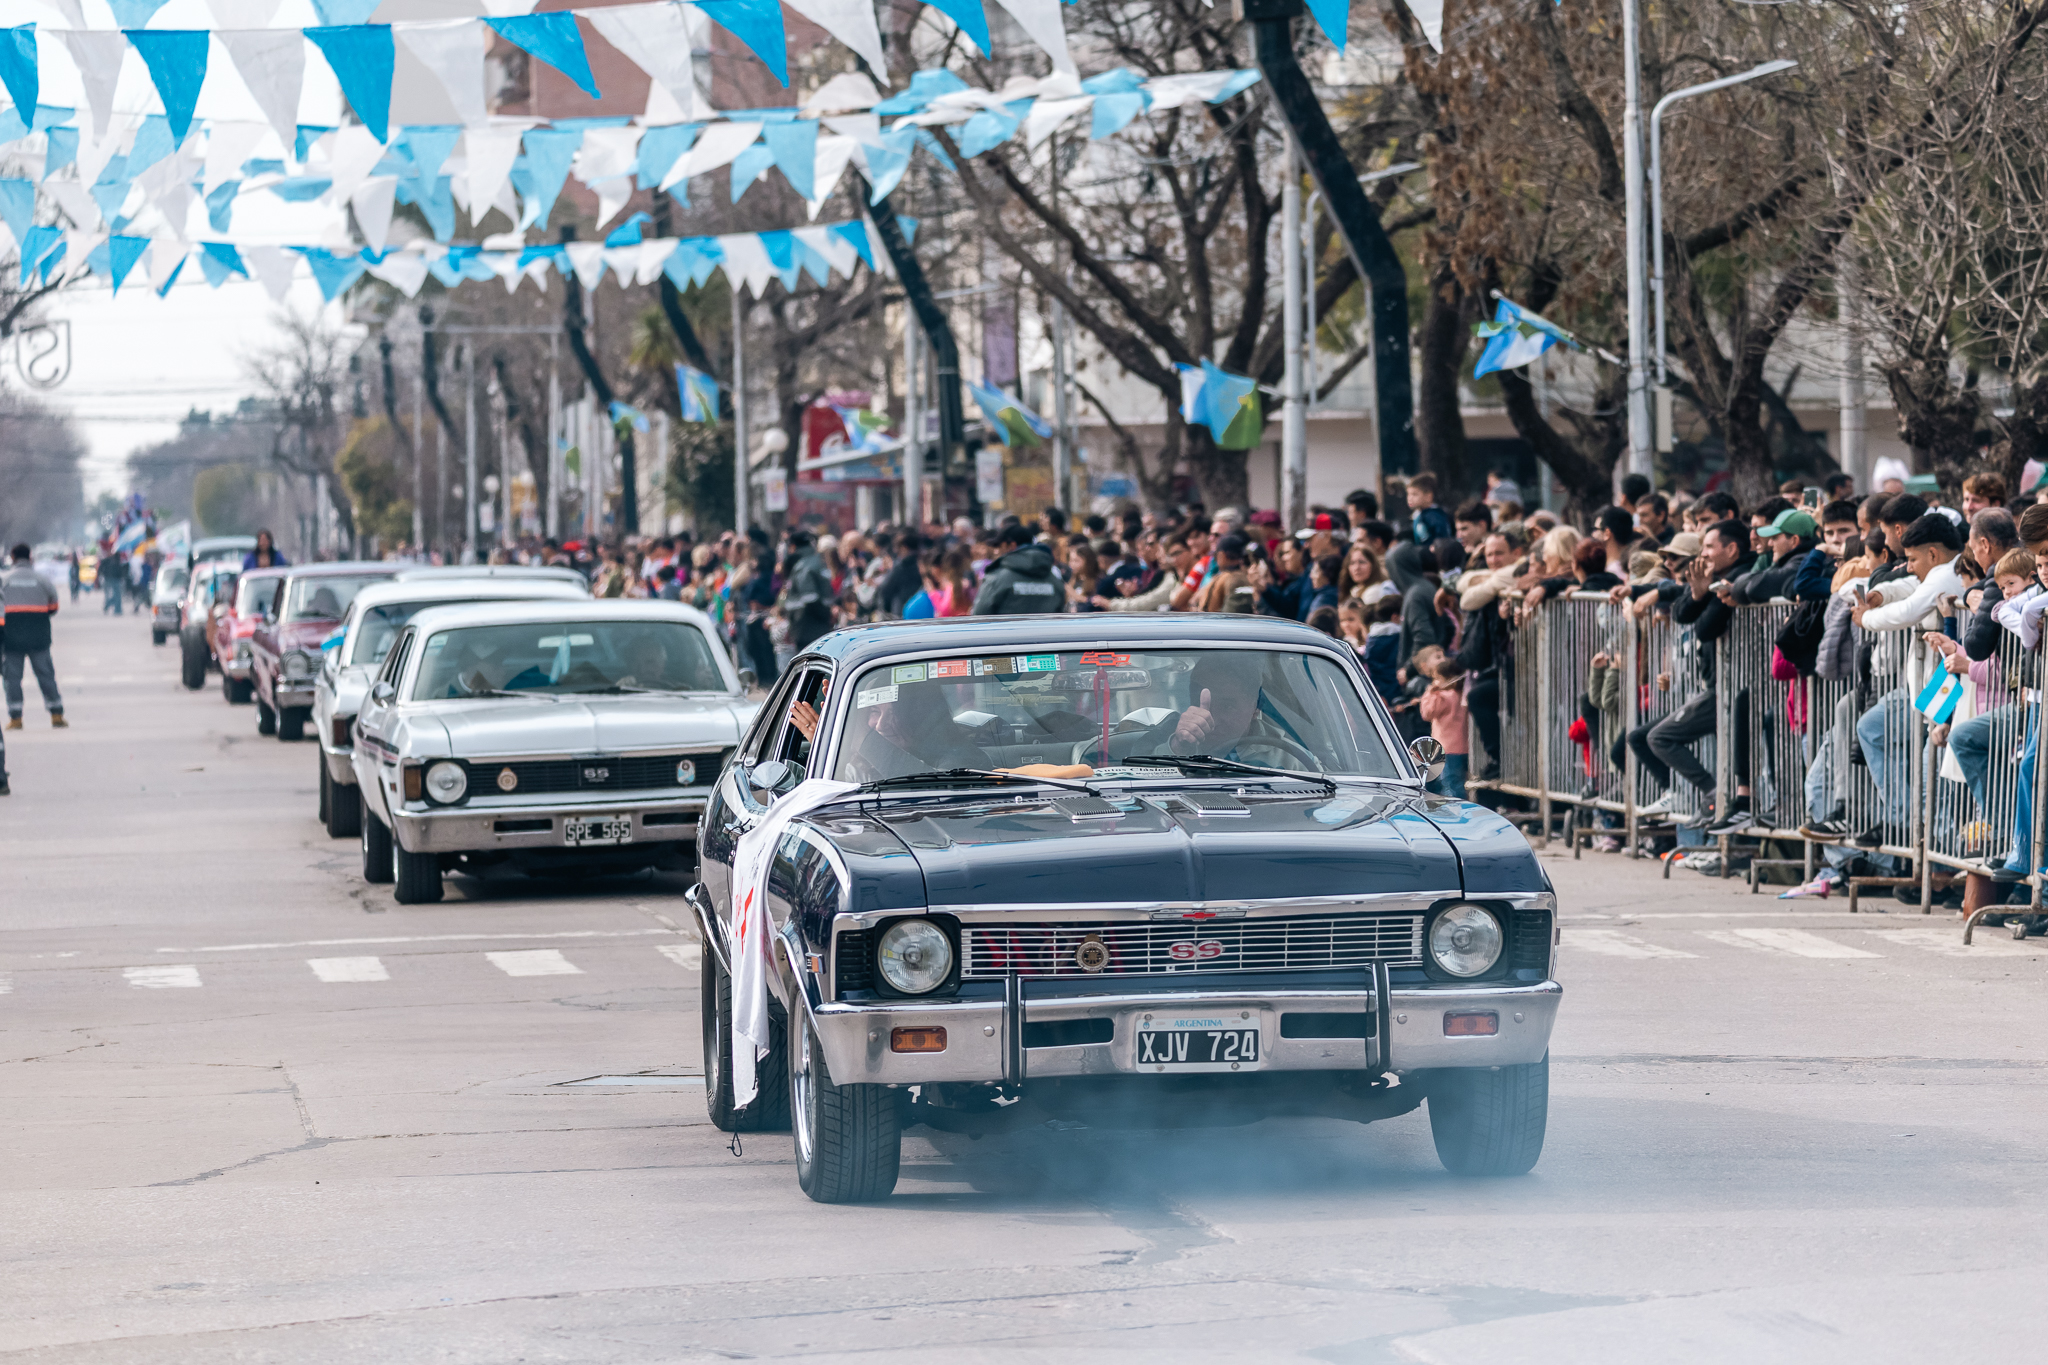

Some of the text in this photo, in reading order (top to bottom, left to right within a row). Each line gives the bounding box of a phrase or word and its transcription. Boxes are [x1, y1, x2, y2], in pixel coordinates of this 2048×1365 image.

[567, 822, 630, 841] SPE 565
[1170, 941, 1223, 960] SS
[1174, 1019, 1223, 1028] ARGENTINA
[1142, 1031, 1255, 1062] XJV 724
